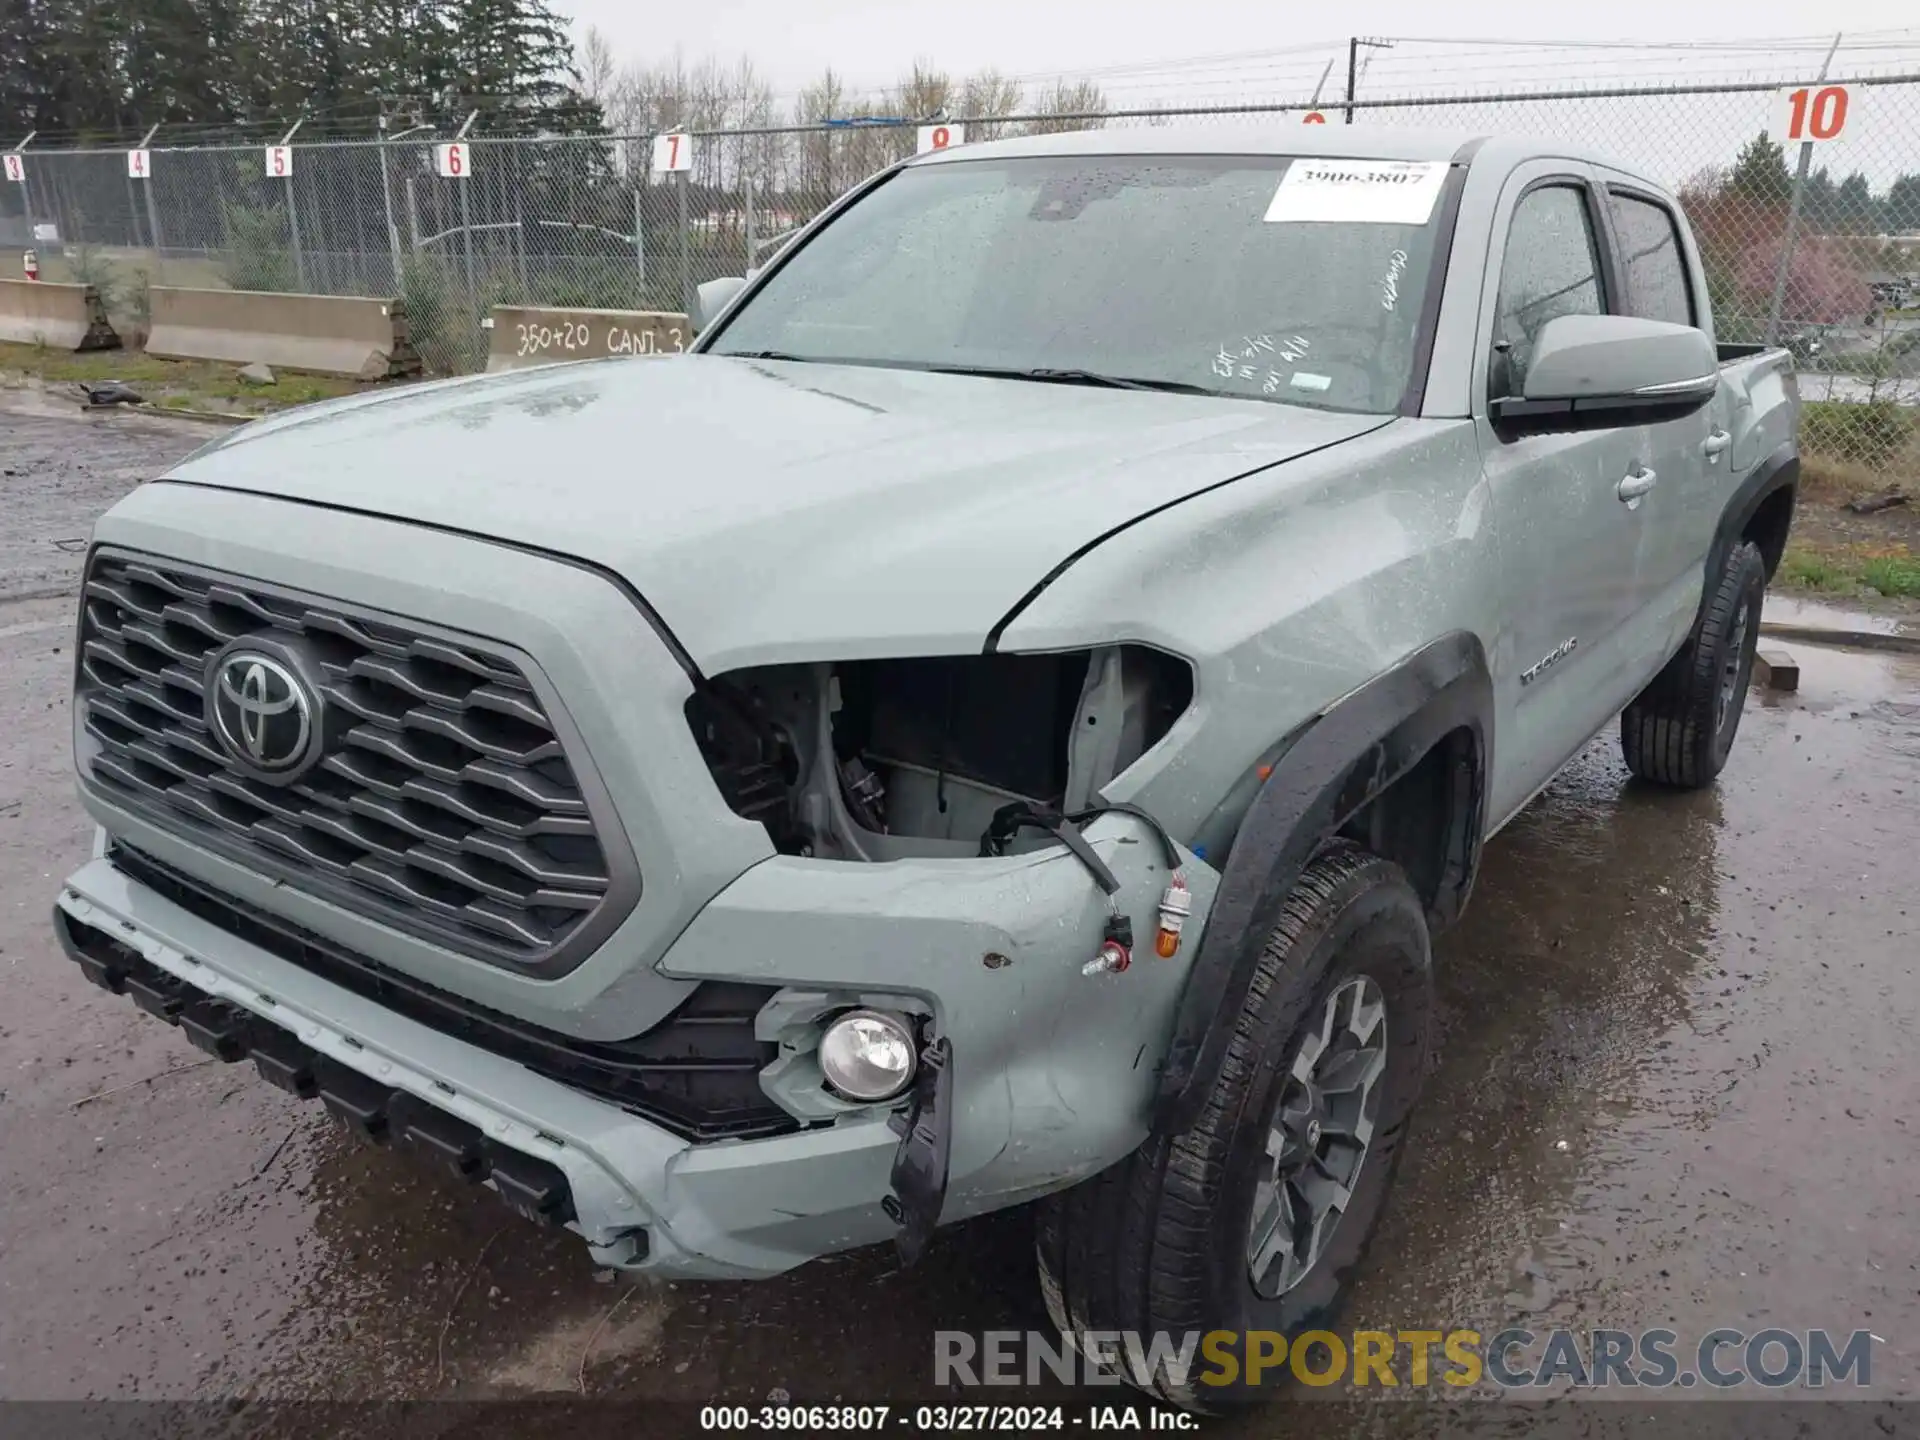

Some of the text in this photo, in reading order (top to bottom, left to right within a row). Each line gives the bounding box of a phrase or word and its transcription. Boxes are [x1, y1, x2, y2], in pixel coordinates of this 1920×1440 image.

[1788, 86, 1849, 140] 10
[134, 151, 144, 175] 4
[274, 148, 285, 175] 5
[449, 145, 462, 175] 6
[667, 135, 680, 169] 7
[9, 156, 20, 179] 3
